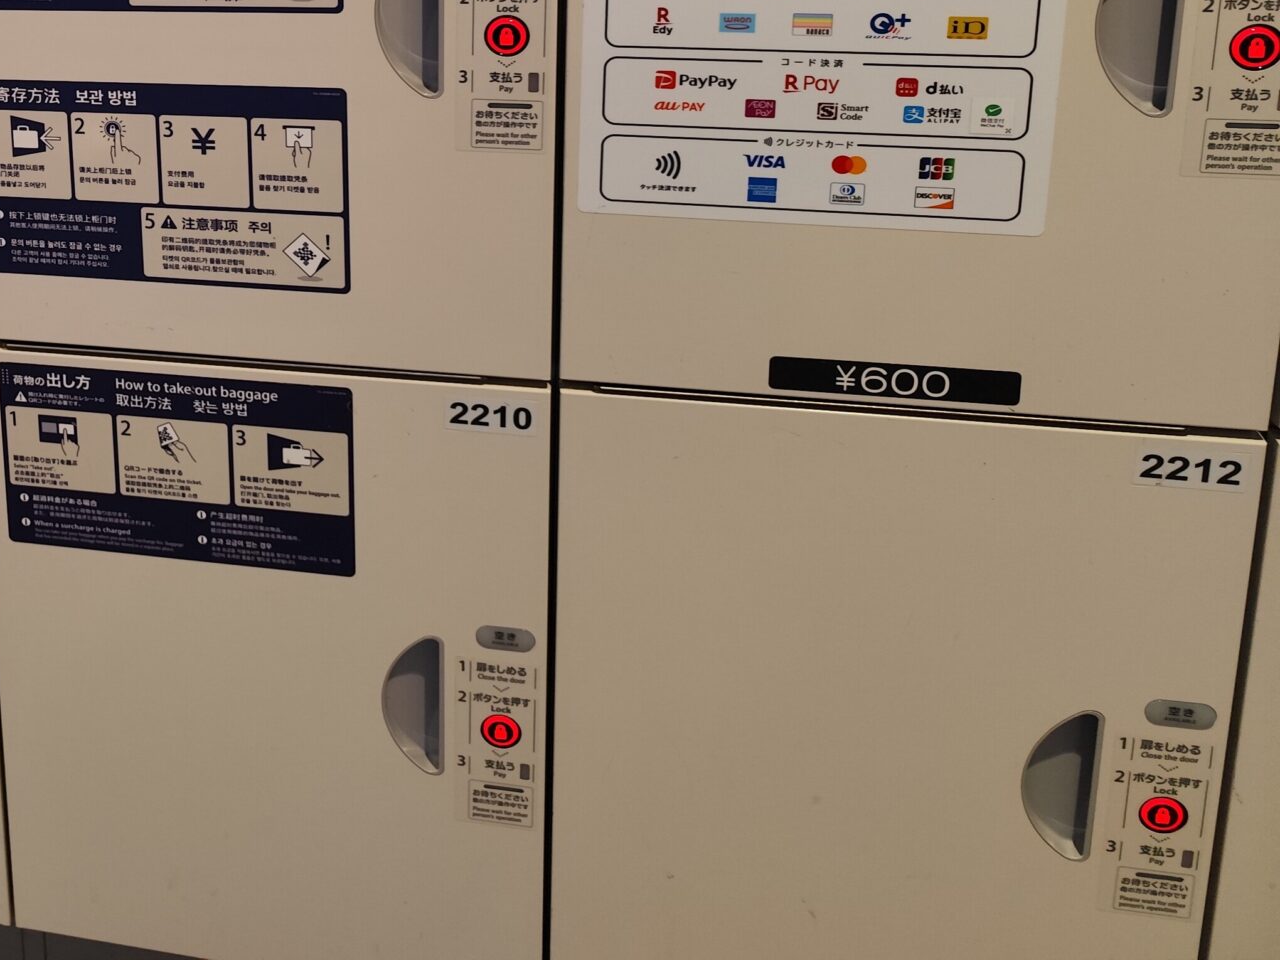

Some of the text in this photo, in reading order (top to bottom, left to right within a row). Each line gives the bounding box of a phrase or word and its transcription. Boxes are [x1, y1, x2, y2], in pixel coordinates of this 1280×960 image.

[496, 4, 519, 13] Lock
[657, 7, 670, 23] R
[1247, 13, 1275, 22] Lock
[652, 26, 673, 35] Edy
[951, 20, 986, 35] iD
[781, 58, 843, 68] コード決済
[459, 70, 523, 83] 3 支払う
[679, 74, 737, 90] PayPay
[783, 74, 840, 94] R Pay
[498, 85, 513, 94] Pay
[925, 82, 964, 95] d払い
[1192, 87, 1271, 101] 3 支払う
[74, 89, 138, 106] 보관 방법
[654, 101, 705, 111] au PAY
[840, 104, 869, 112] Smart
[926, 108, 962, 118] 支付宝
[1241, 103, 1259, 113] Pay
[475, 110, 538, 120] お待ちください
[840, 113, 863, 121] Code
[74, 118, 85, 135] 2
[163, 120, 174, 137] 3
[253, 124, 267, 140] 4
[777, 139, 854, 149] クレジットカード
[743, 154, 786, 169] VISA
[919, 164, 954, 173] JCB
[916, 192, 953, 200] DISCOVER
[144, 213, 272, 234] 5 注意事项 주의
[13, 372, 91, 390] 荷物の出し方
[835, 364, 951, 397] ¥600
[115, 378, 278, 403] How to take out baggage
[116, 394, 248, 417] 取出方法 찾는 방법
[9, 411, 17, 426] 1
[449, 402, 532, 430] 2210
[120, 420, 132, 436] 2
[235, 430, 247, 446] 3
[1139, 453, 1243, 486] 2212
[1120, 737, 1202, 756] 1 扉をしめる
[1114, 771, 1202, 789] 2 ボタンを押す
[1153, 787, 1179, 796] Lock
[1106, 840, 1176, 857] 3 支払う
